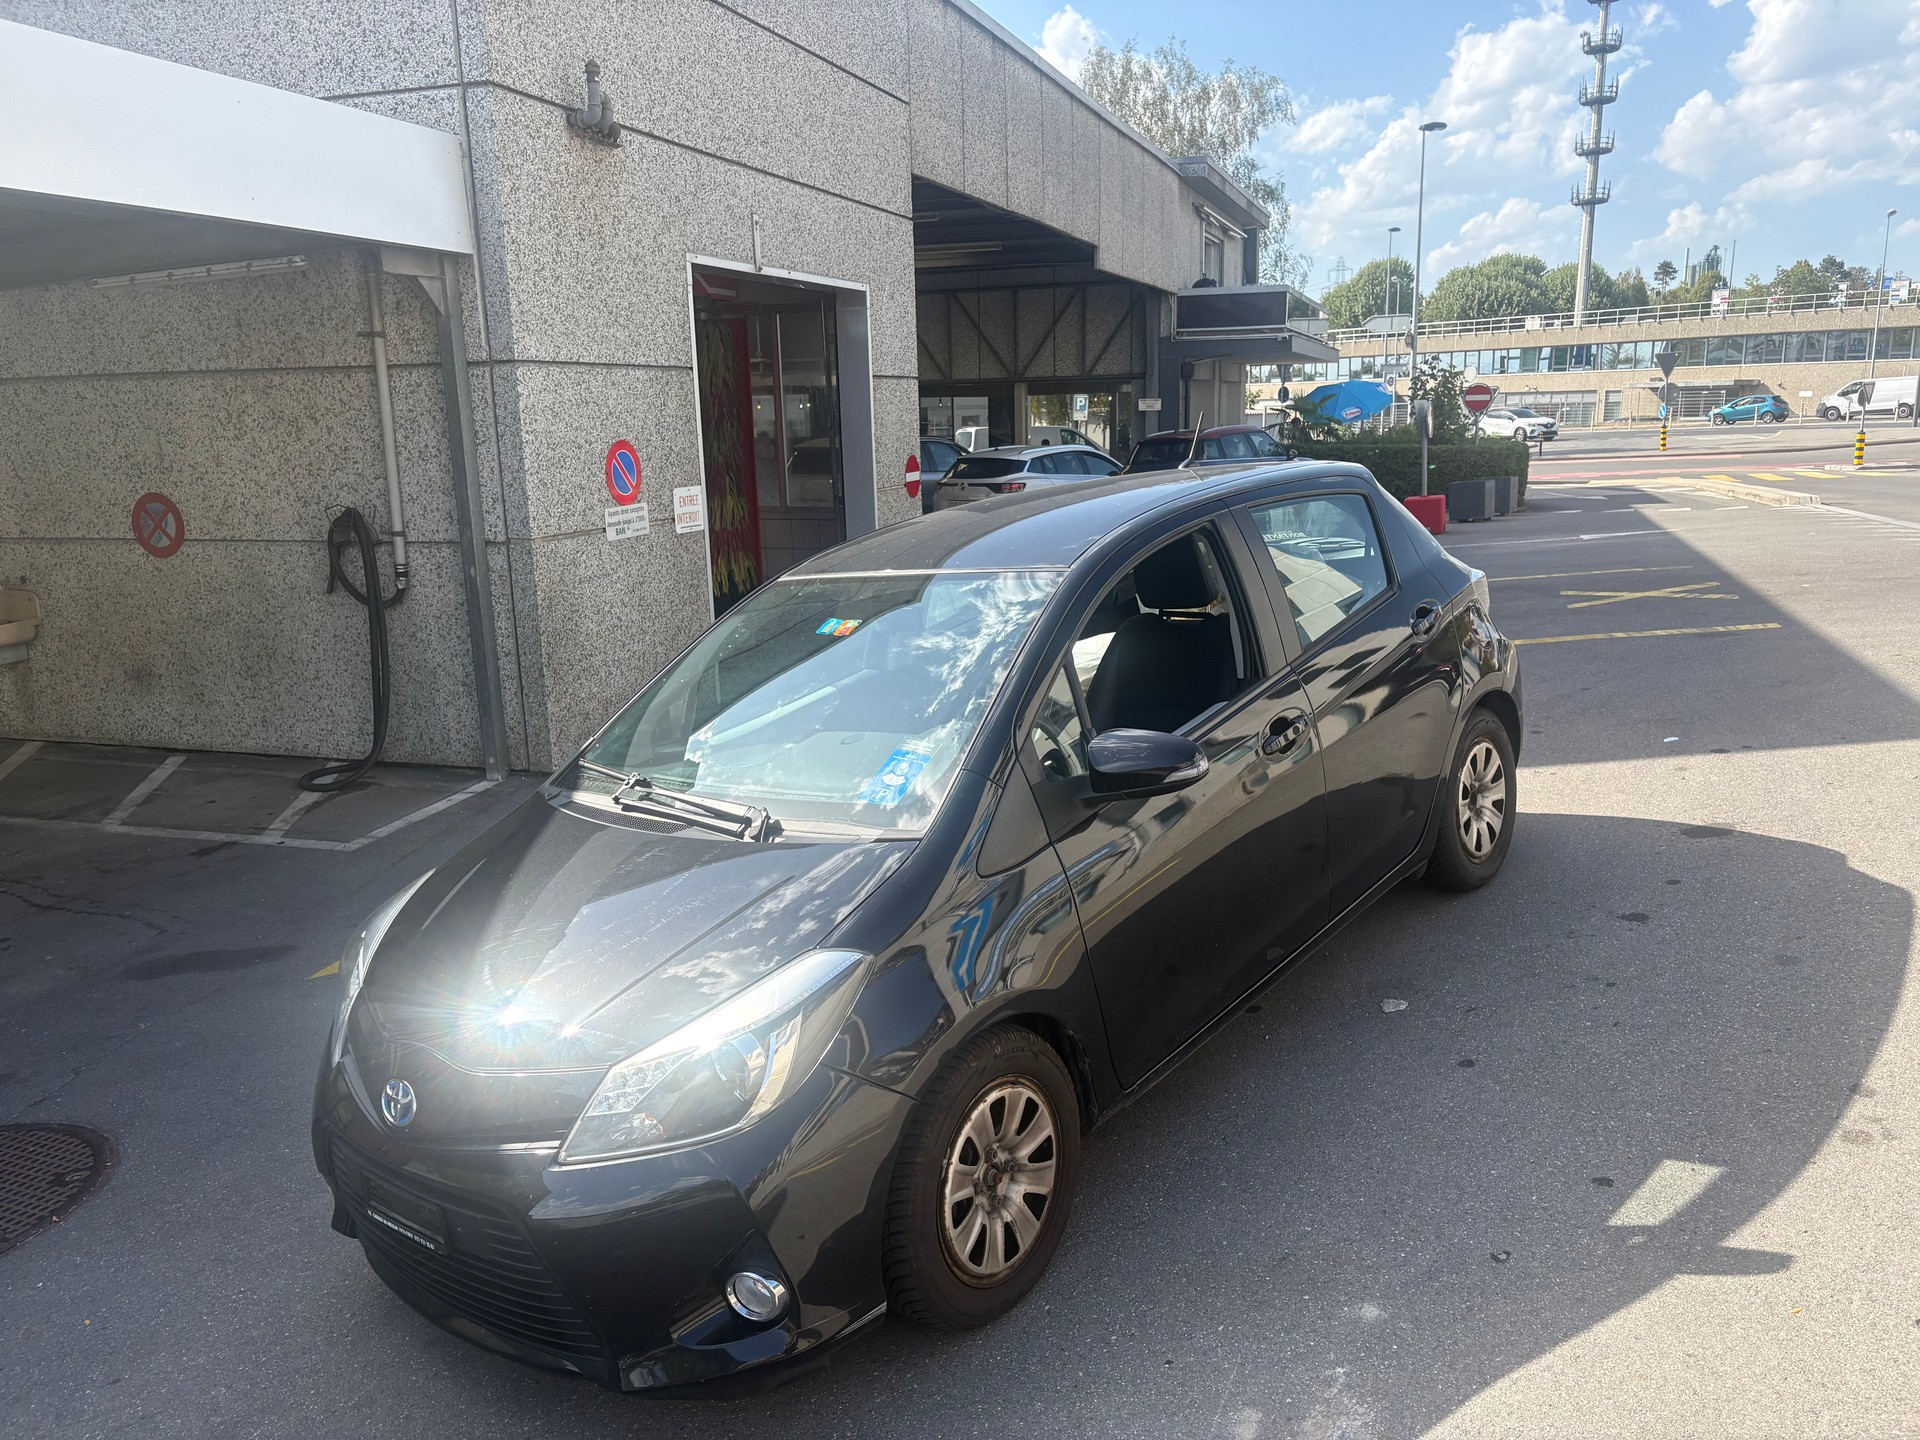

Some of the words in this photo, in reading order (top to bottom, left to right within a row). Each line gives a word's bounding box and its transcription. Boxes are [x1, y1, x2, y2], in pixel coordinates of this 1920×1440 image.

[1077, 398, 1085, 410] P
[679, 494, 699, 507] ENTREE
[616, 526, 626, 536] BAN
[877, 789, 890, 799] P
